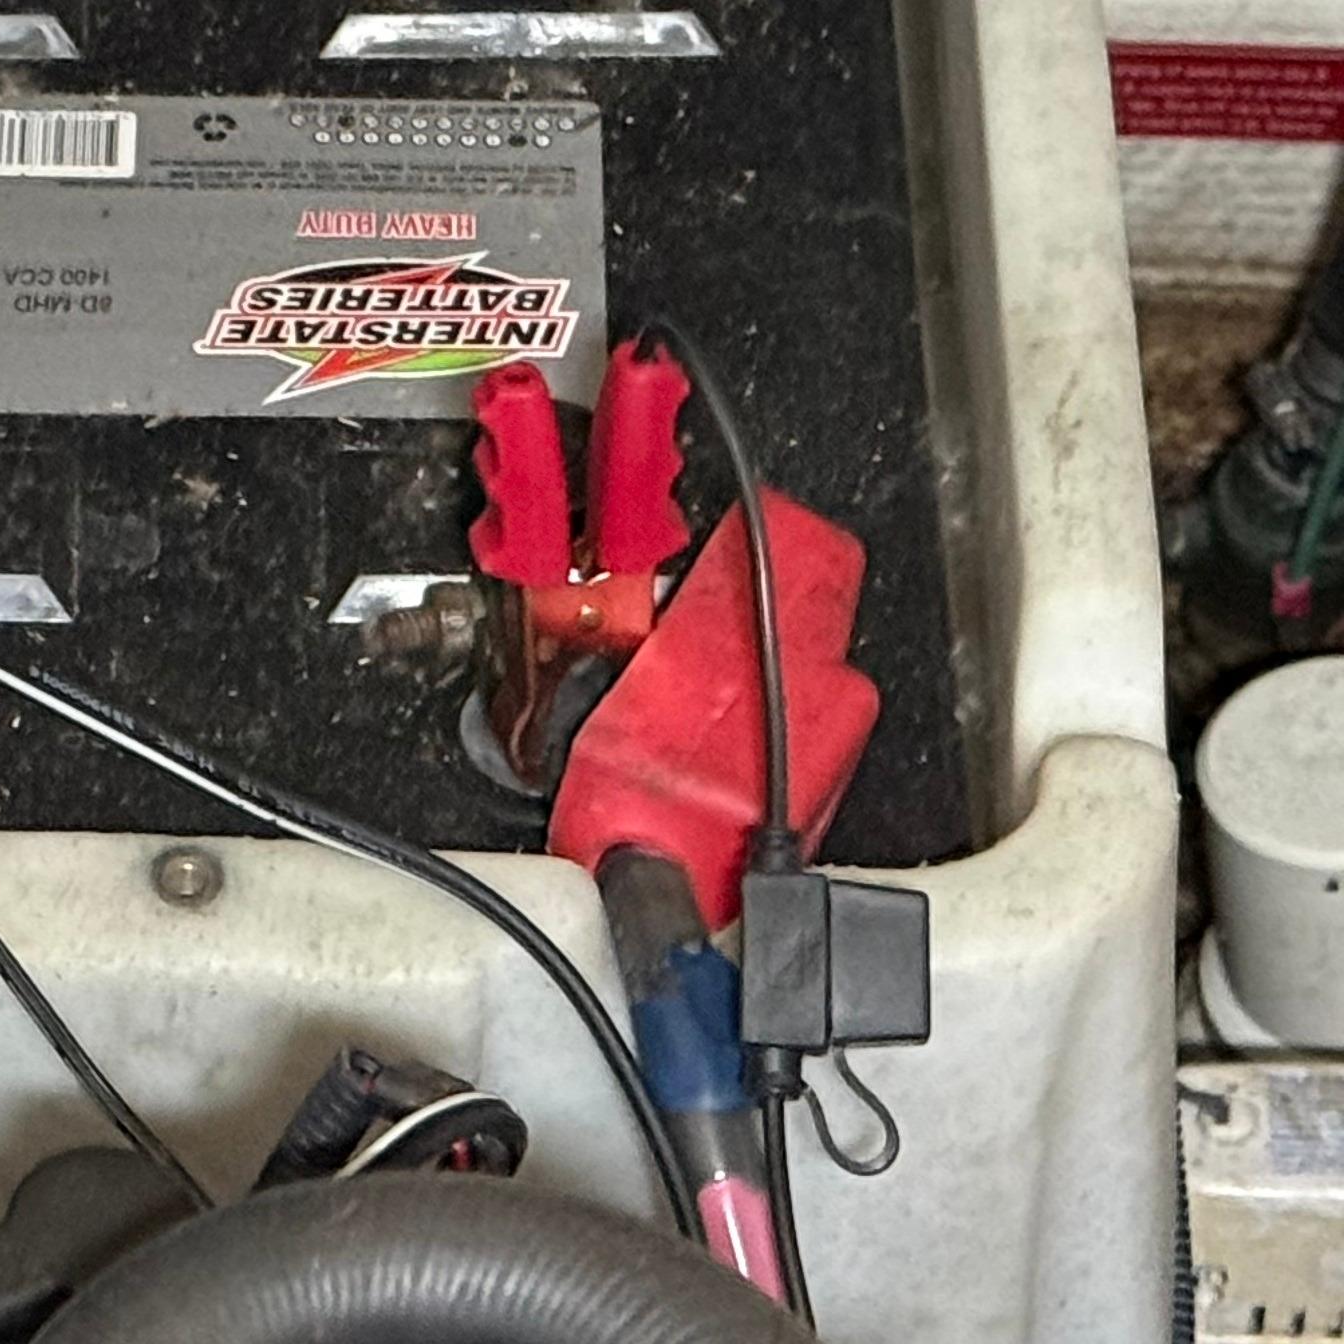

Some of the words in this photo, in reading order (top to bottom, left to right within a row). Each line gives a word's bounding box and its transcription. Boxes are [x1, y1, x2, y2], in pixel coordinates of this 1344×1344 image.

[296, 212, 377, 240] DUTY
[381, 212, 477, 240] HEAVY
[3, 268, 54, 287] CCA
[59, 268, 110, 287] 1400
[241, 286, 551, 314] BATTERIES
[221, 316, 558, 346] INTERSTATE
